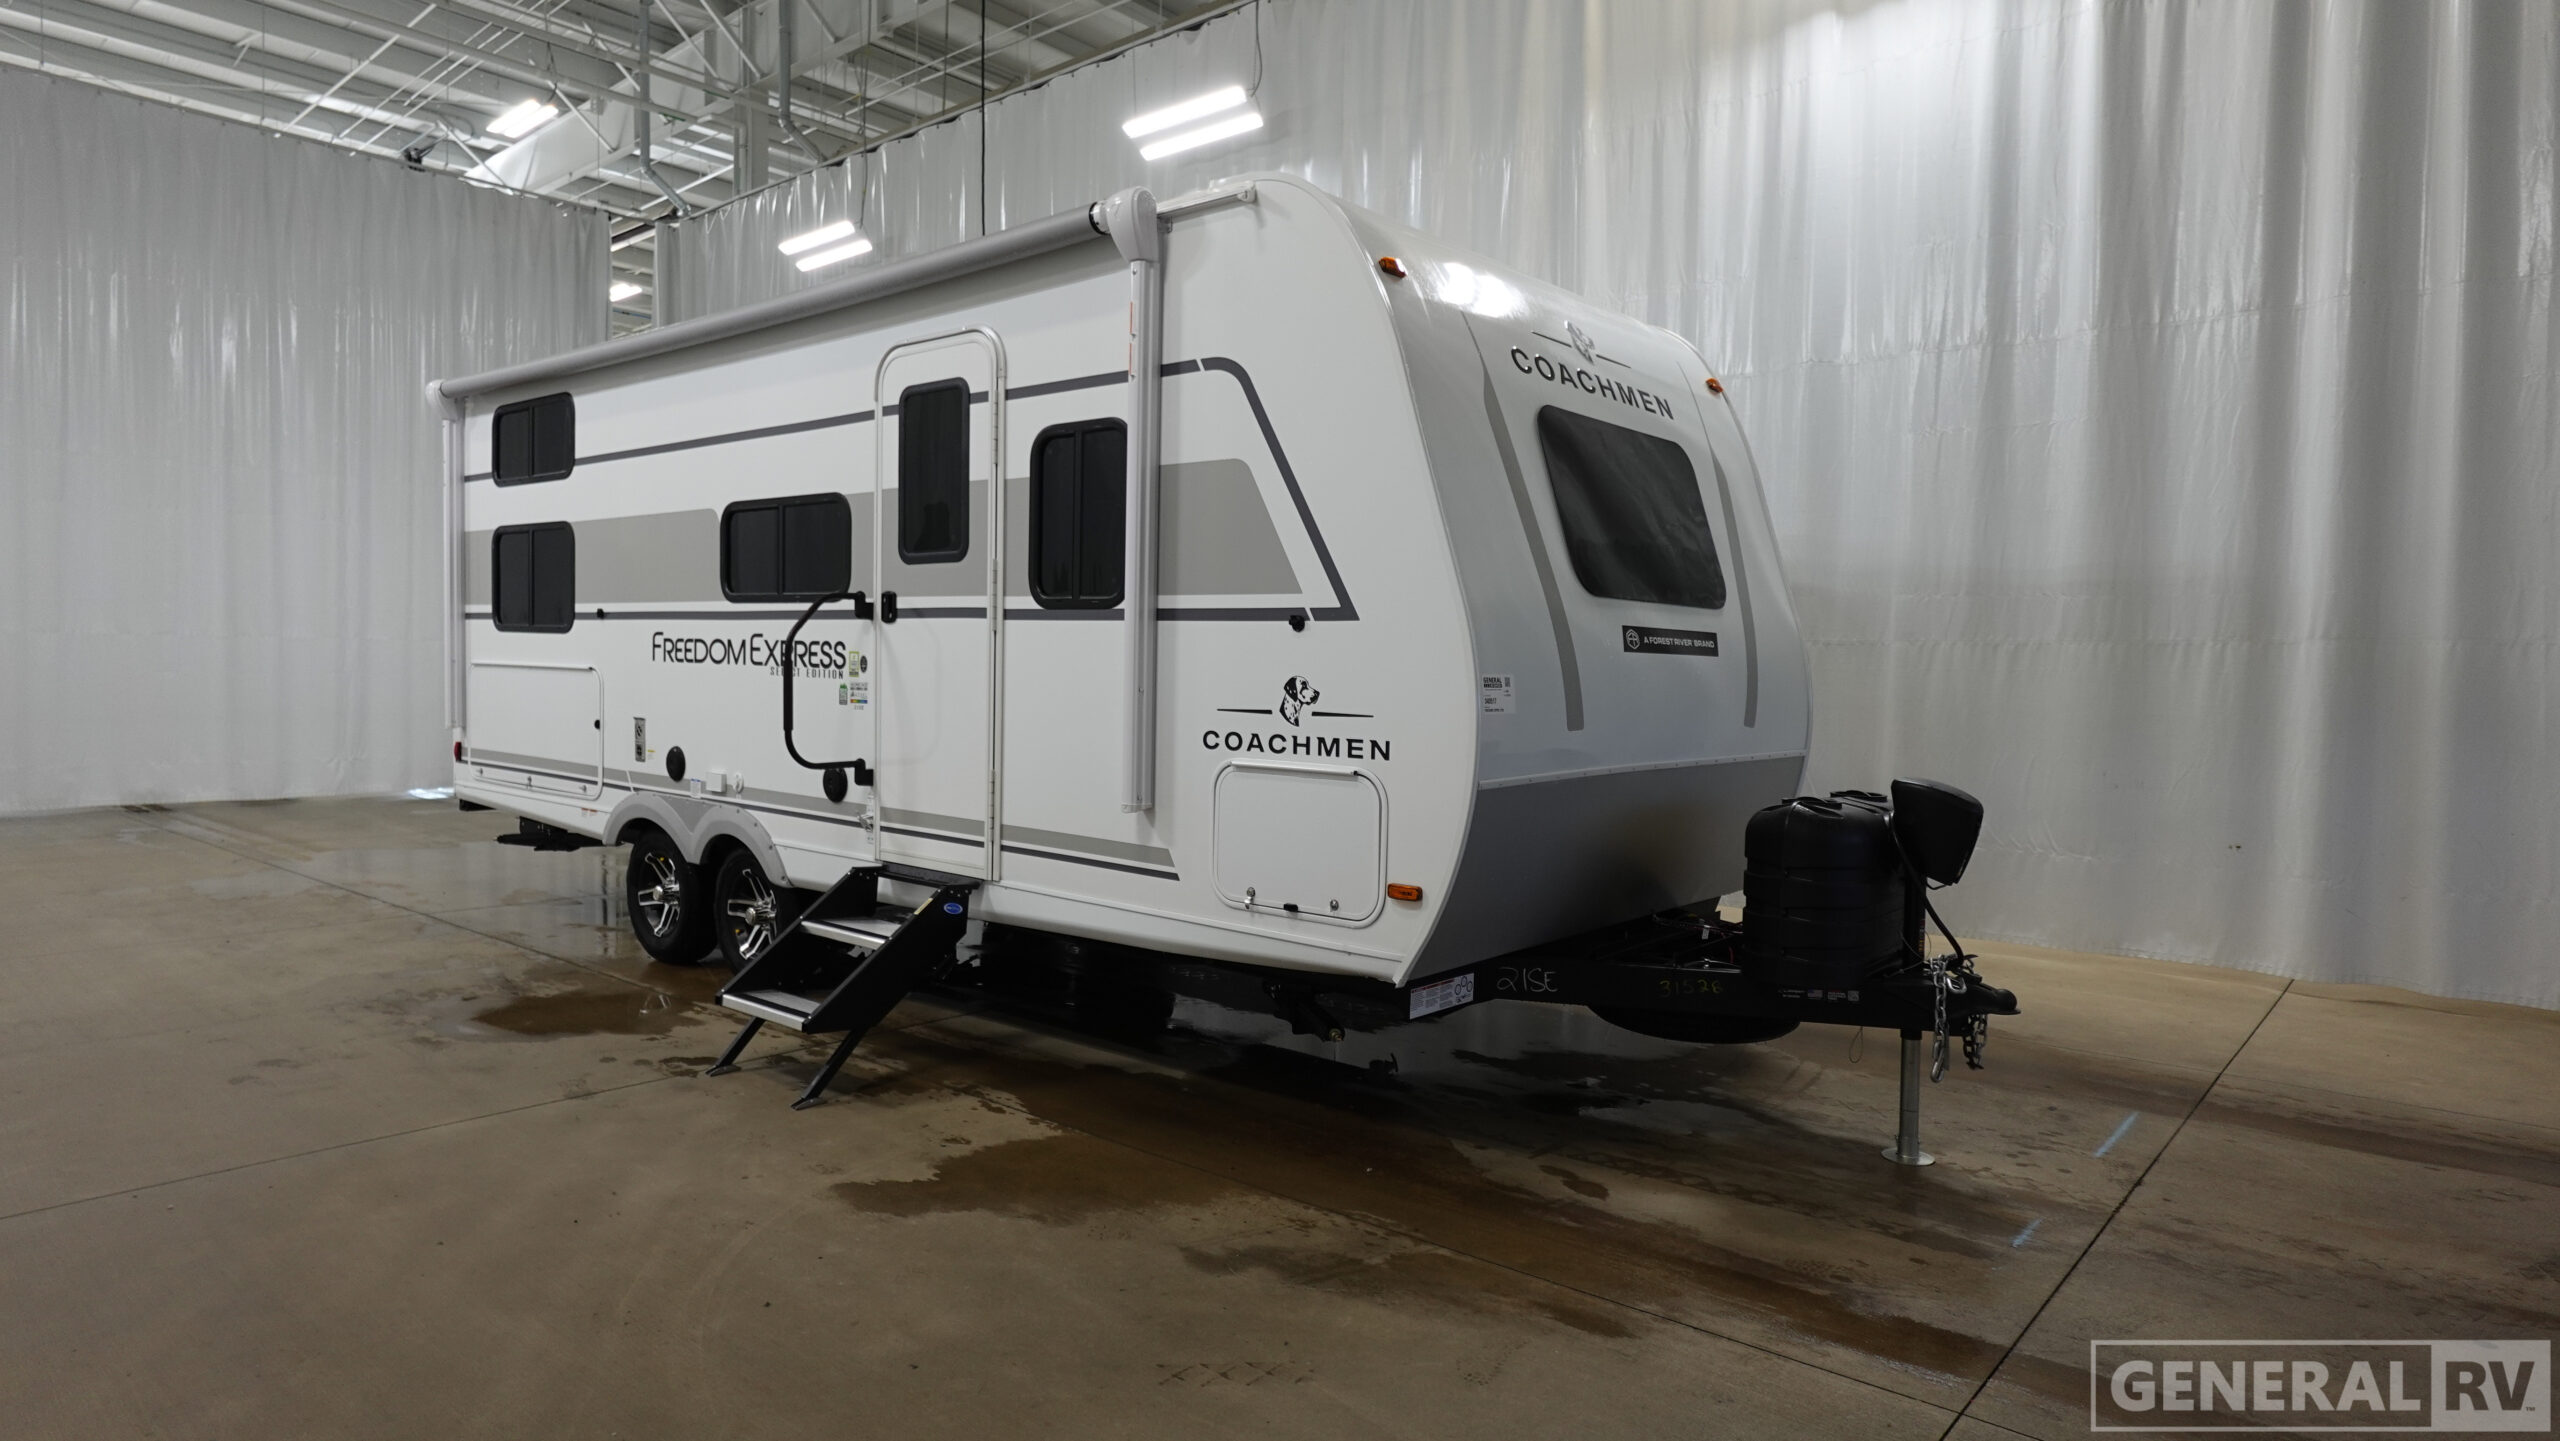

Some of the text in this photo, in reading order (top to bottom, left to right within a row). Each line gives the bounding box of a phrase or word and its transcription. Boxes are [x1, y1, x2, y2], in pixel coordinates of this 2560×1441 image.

[1511, 346, 1674, 420] COACHMEN
[652, 632, 746, 665] FREEDOM
[1649, 636, 1673, 645] FOREST
[1674, 638, 1692, 647] RIVER
[1694, 640, 1715, 648] BRAND
[806, 668, 844, 680] EDITION
[1202, 730, 1390, 761] COACHMEN
